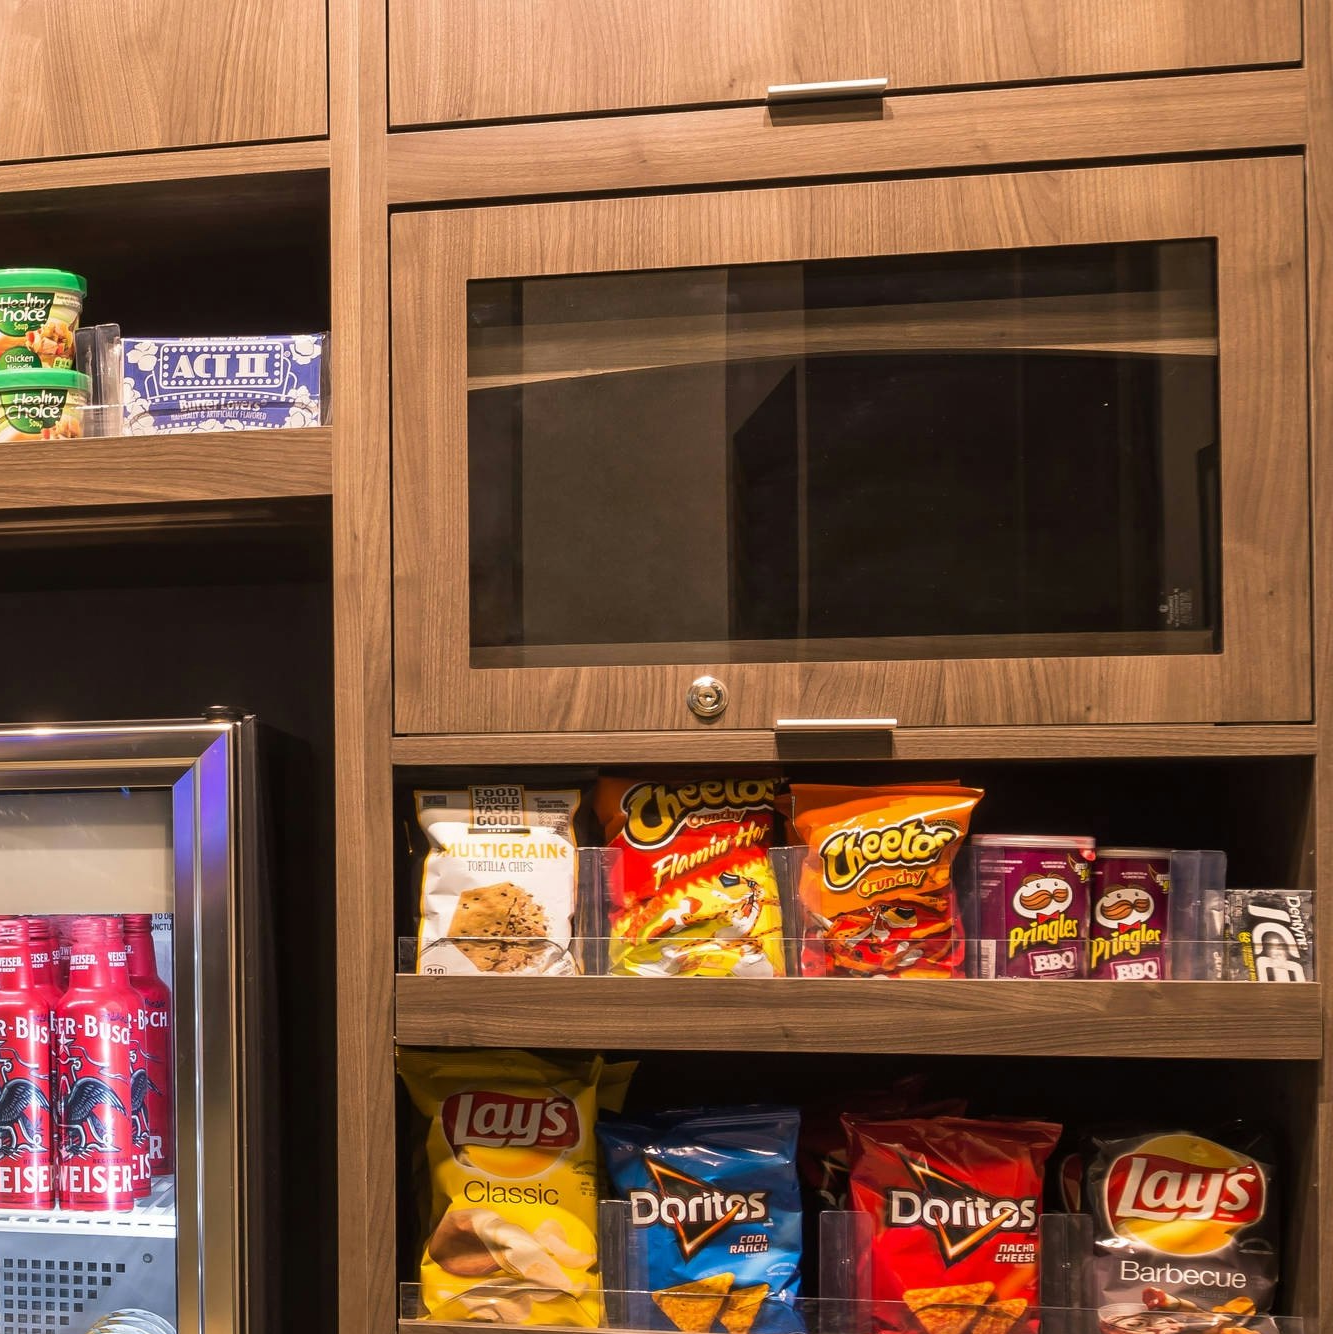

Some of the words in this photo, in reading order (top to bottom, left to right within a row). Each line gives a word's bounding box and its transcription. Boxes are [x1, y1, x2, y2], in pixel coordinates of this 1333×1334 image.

[0, 292, 51, 311] Healthy
[13, 322, 28, 331] Soup
[4, 354, 34, 363] Chicken
[172, 353, 231, 379] ACT
[235, 353, 269, 378] II
[13, 389, 65, 406] Healthy
[180, 398, 219, 412] Butter
[221, 397, 261, 412] Lovers
[5, 404, 60, 420] Choice
[474, 787, 519, 797] FOOD
[475, 796, 520, 805] SHOULD
[475, 805, 520, 815] TASTE
[629, 778, 777, 843] Cheetos
[476, 815, 521, 826] GOOD
[688, 811, 746, 828] Crunchy
[735, 824, 771, 848] Hot
[443, 842, 560, 859] MULTIGRAIN
[823, 819, 958, 886] Cheetos
[467, 860, 506, 872] TORTILLA
[508, 861, 534, 873] CHIPS
[857, 869, 927, 897] Crunchy
[1008, 916, 1078, 958] Pringles
[1091, 928, 1162, 969] Pringles
[1032, 950, 1077, 974] BBQ
[1116, 961, 1160, 980] BBQ
[453, 1094, 570, 1147] Lay's
[463, 1180, 560, 1206] Classic
[1115, 1157, 1255, 1222] Lay's
[631, 1190, 767, 1226] Doritos
[890, 1190, 1036, 1228] Doritos
[740, 1233, 768, 1244] COOL
[729, 1243, 768, 1255] RANCH
[998, 1244, 1035, 1253] NACHO
[994, 1253, 1036, 1263] CHEESE
[1120, 1261, 1247, 1289] Barbecue
